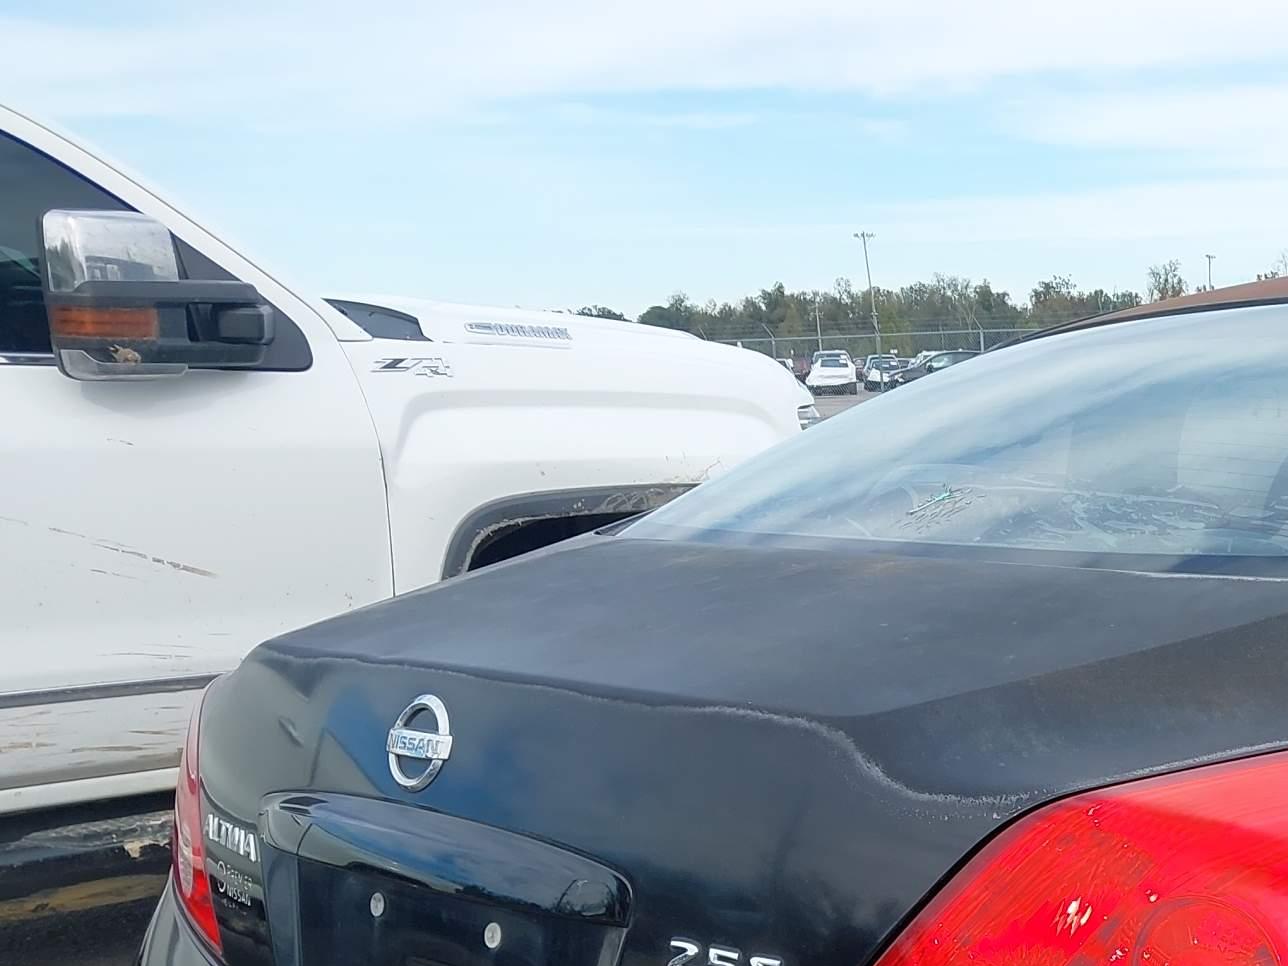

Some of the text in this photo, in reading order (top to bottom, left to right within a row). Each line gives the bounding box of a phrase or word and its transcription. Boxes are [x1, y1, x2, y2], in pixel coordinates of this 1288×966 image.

[388, 731, 443, 757] NISSAN
[203, 813, 261, 862] ALTIMA
[226, 884, 252, 907] NISSAN
